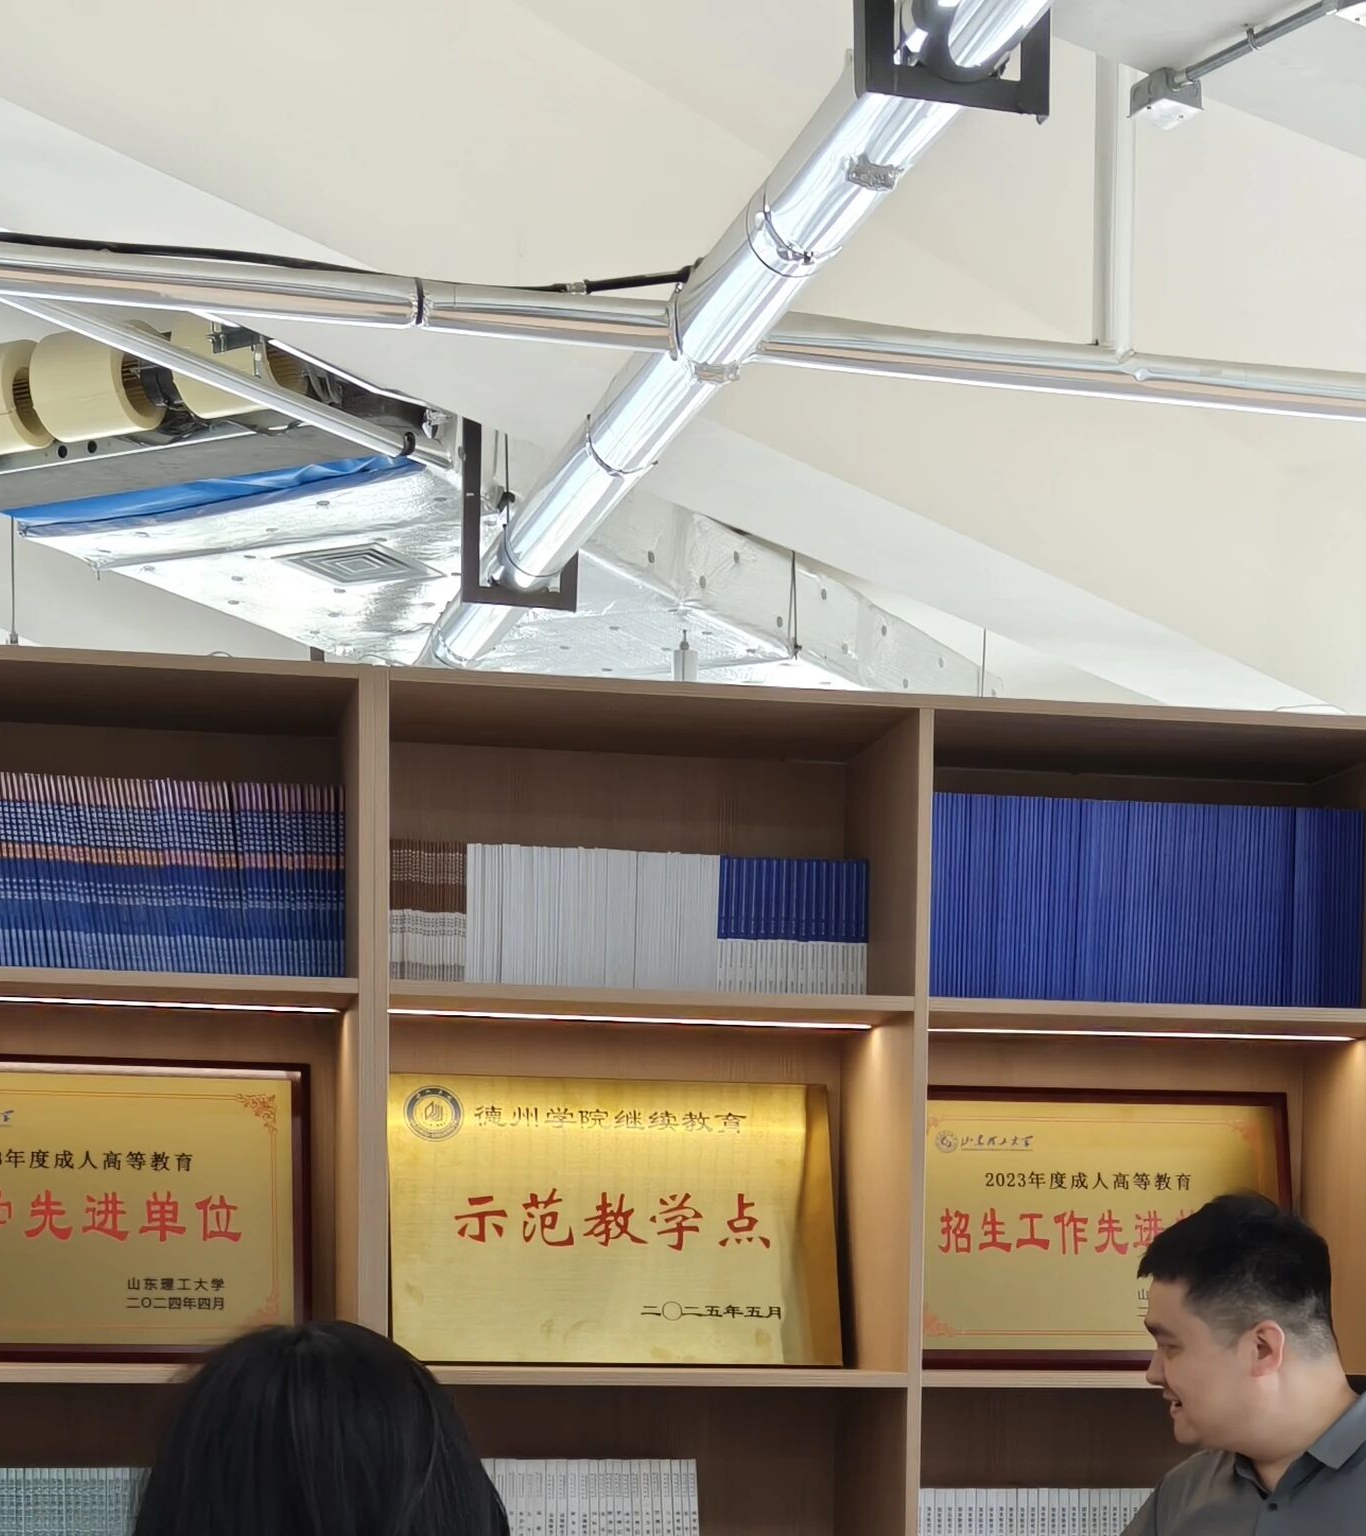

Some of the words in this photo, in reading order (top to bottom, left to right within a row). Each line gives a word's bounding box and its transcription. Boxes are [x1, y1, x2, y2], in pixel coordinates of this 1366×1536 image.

[474, 1105, 747, 1134] 德州学院继续教育
[985, 1171, 1192, 1191] 2023年度成人高等教育
[454, 1188, 772, 1251] 示范教学点
[938, 1208, 1194, 1255] 招生工作先进
[127, 1277, 225, 1292] 山东理工大学
